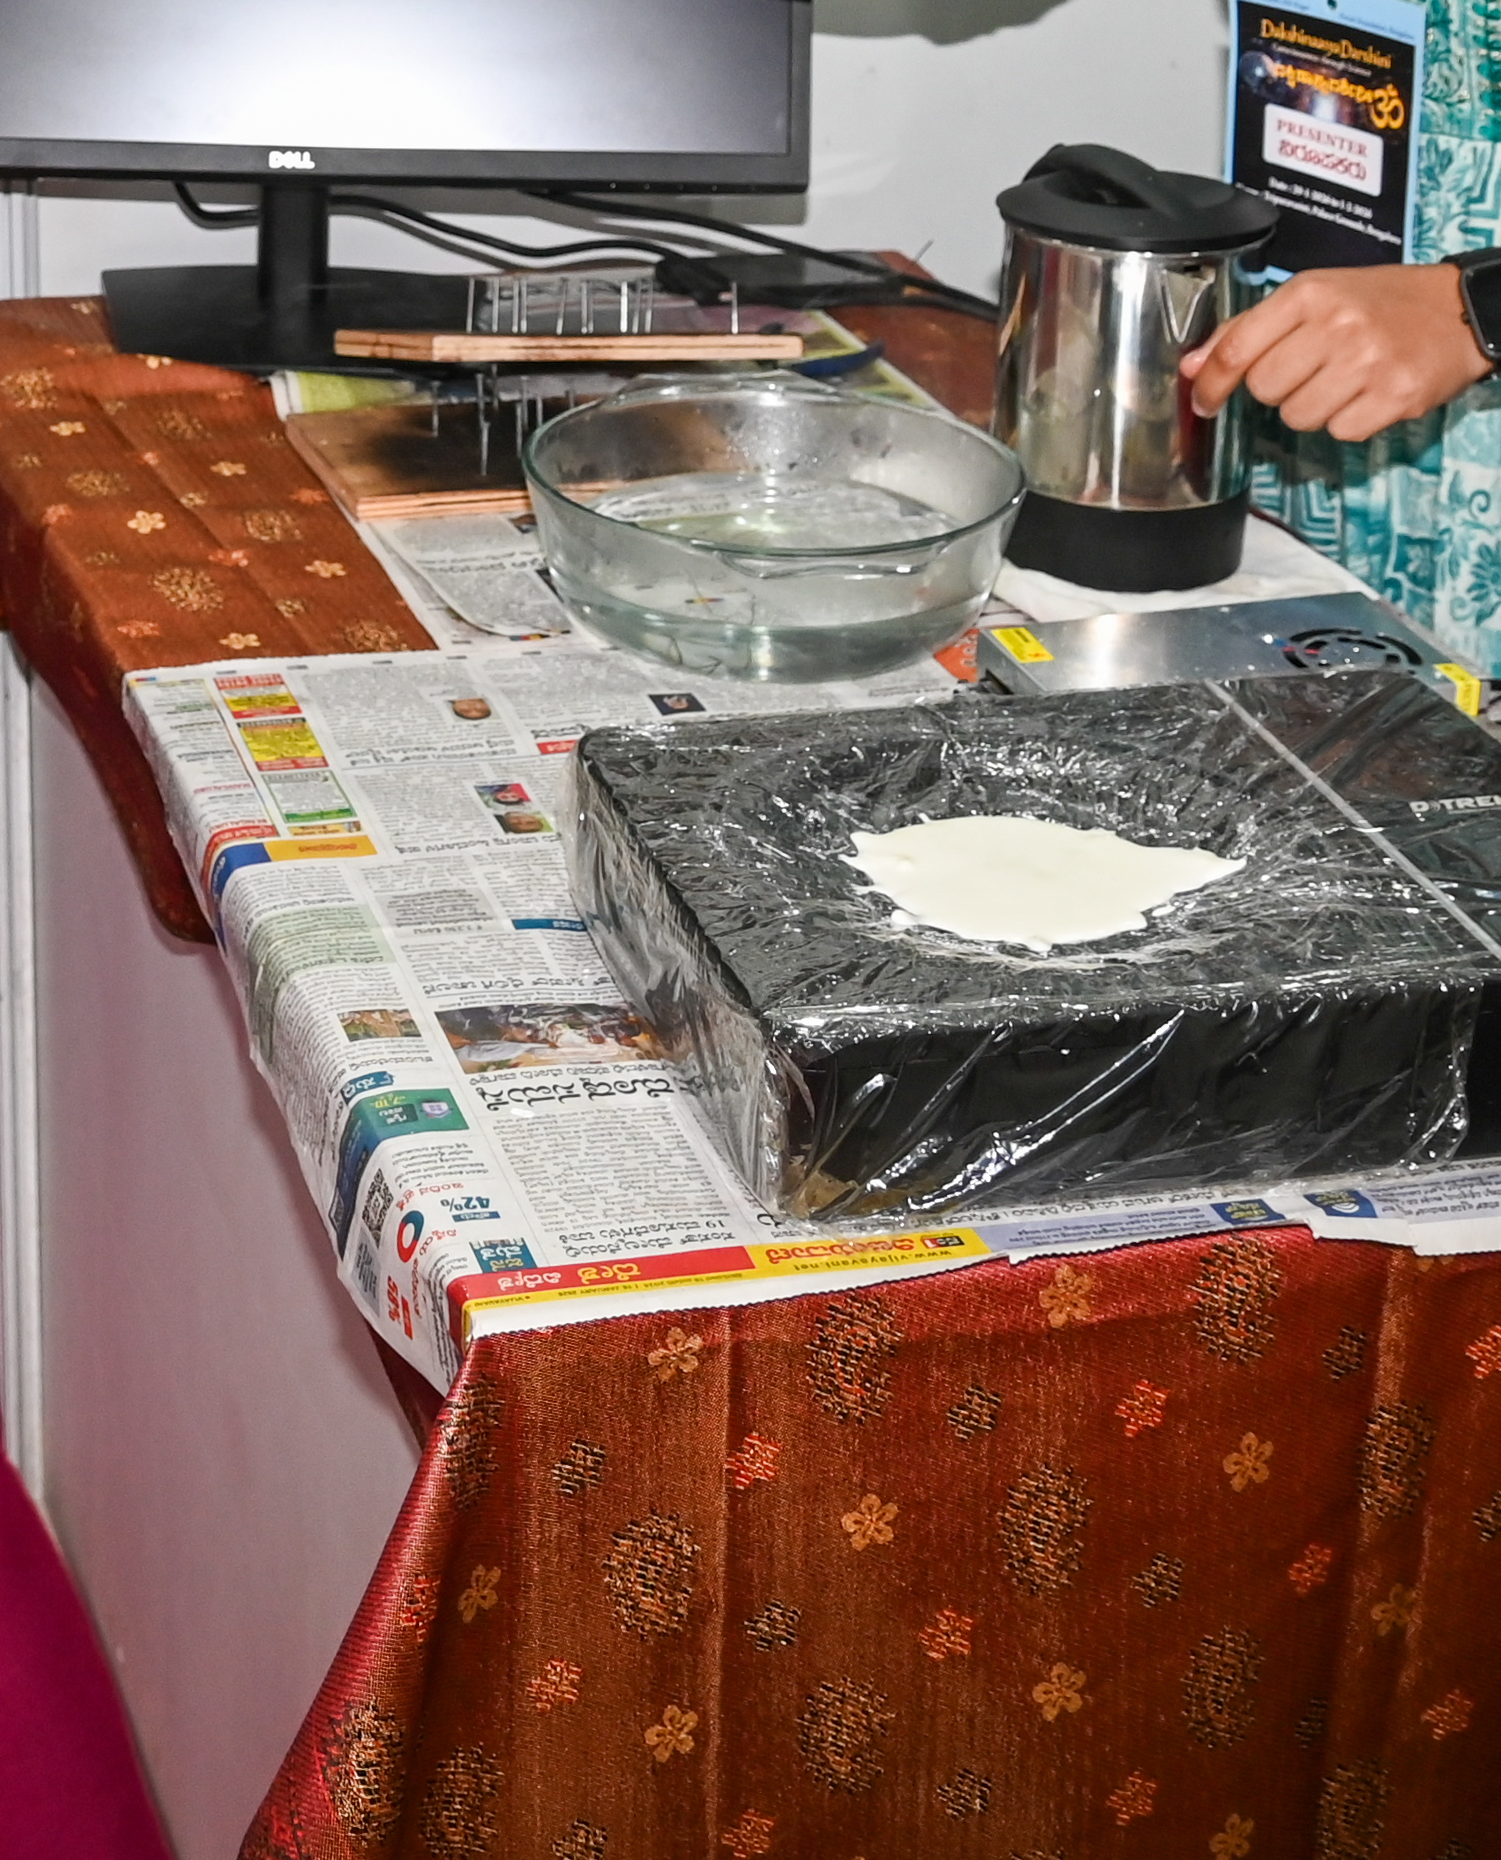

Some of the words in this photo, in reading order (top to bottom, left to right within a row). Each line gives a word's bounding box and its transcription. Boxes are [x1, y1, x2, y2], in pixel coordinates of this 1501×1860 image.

[1278, 120, 1367, 156] PRESENTER
[268, 150, 316, 170] DELL
[439, 1196, 490, 1212] 42%
[765, 1238, 915, 1265] ವಿಜಯವಾಣಿ
[792, 1249, 952, 1272] www.vijayavani.net
[497, 1269, 563, 1291] ವಿದೇಶ
[578, 1262, 642, 1283] ದೇಶ
